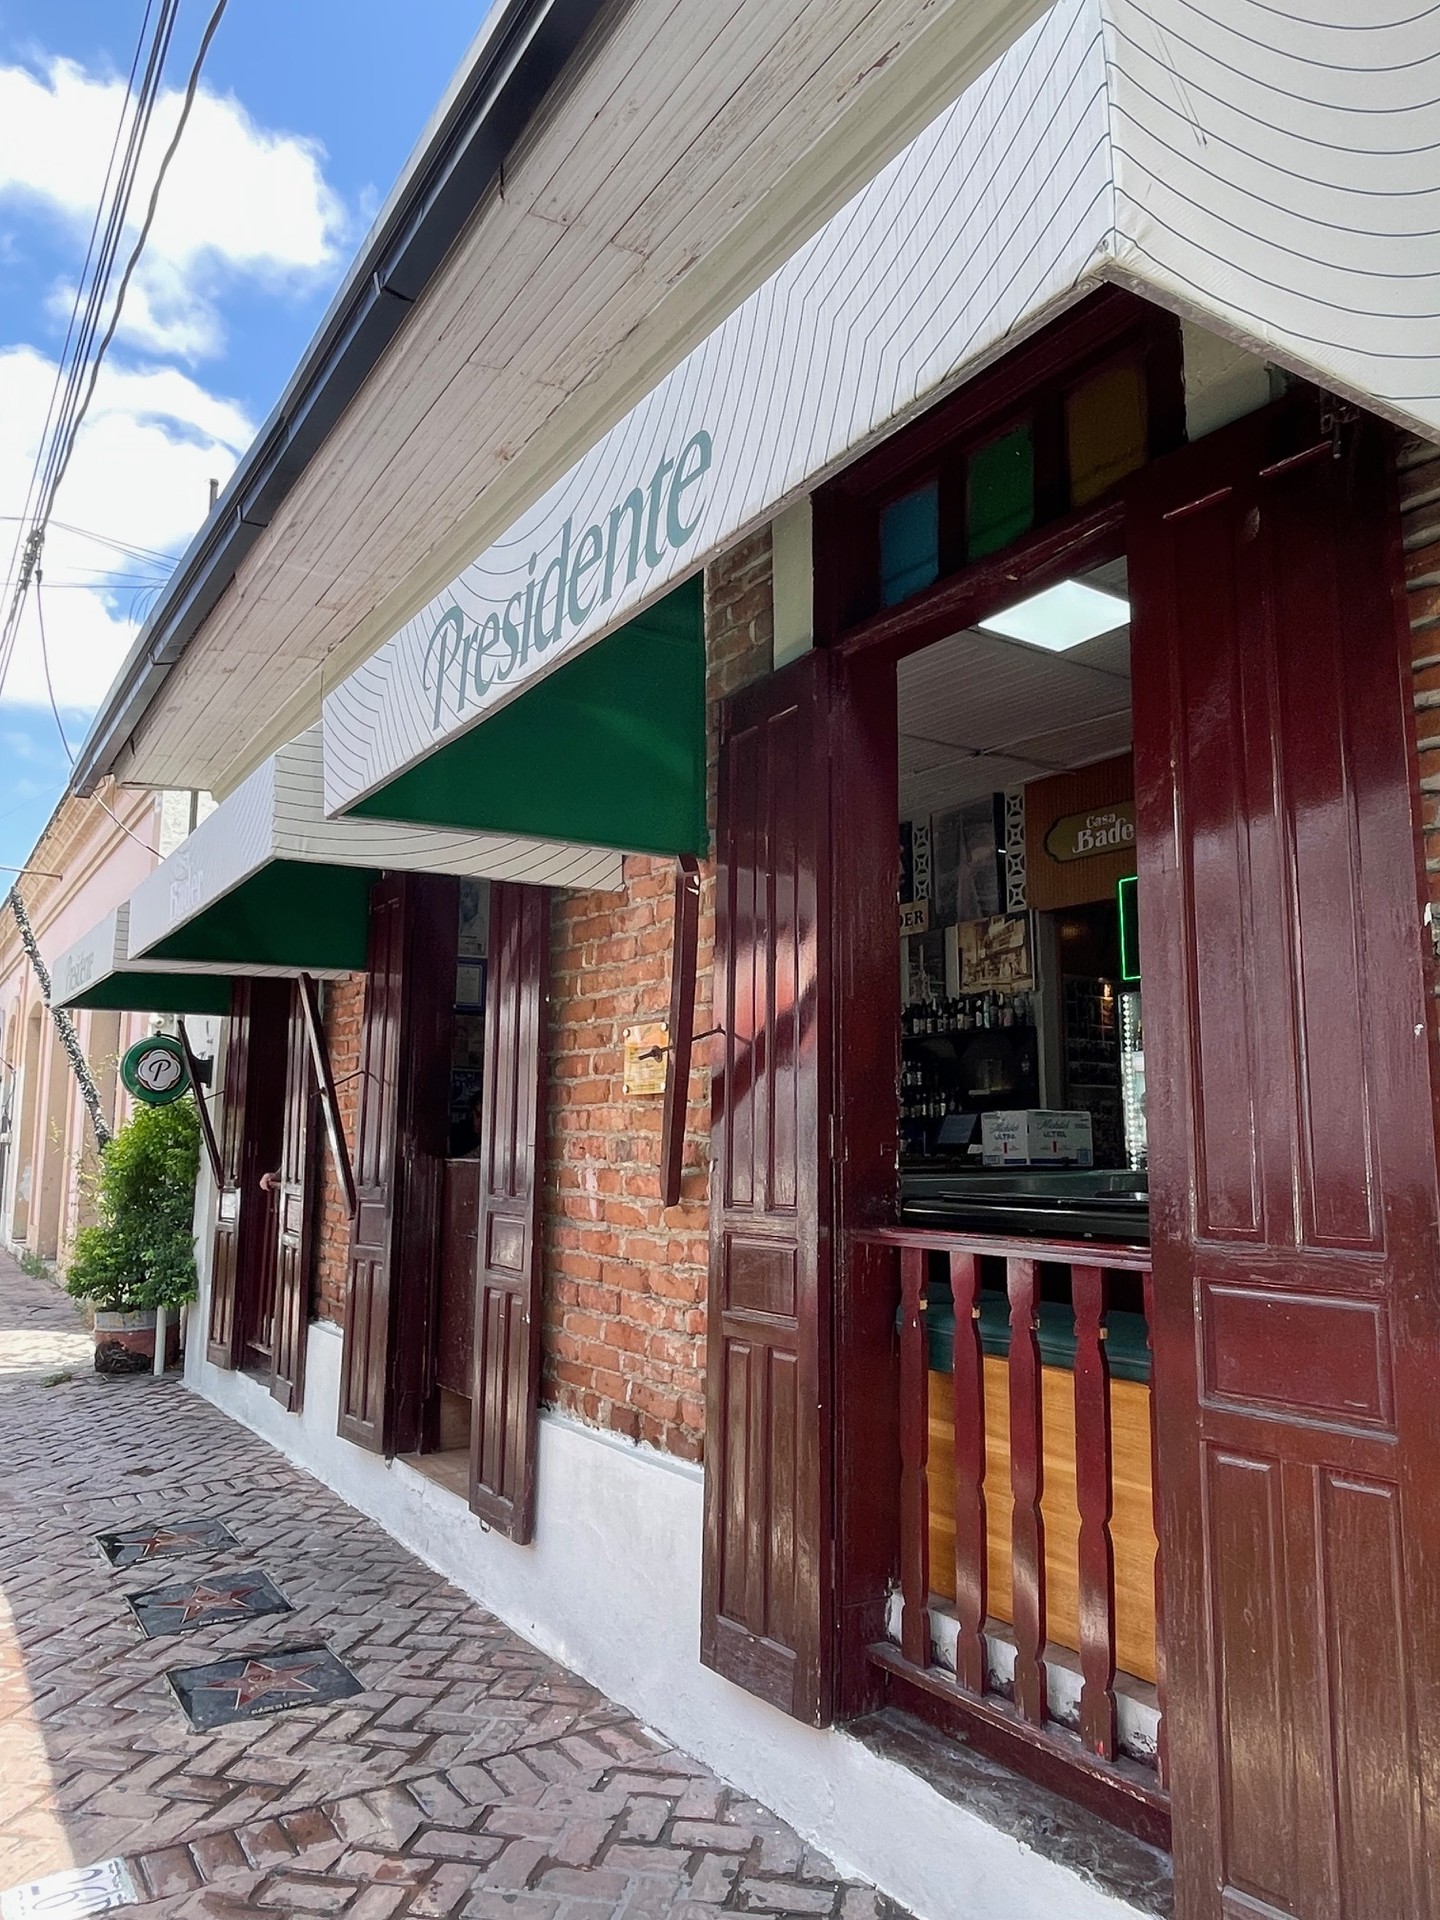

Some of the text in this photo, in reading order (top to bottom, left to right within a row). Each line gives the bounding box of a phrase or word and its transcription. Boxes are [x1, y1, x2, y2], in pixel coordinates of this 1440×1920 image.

[422, 429, 713, 731] Presidente
[1086, 813, 1116, 829] Casa
[1072, 817, 1135, 853] Bade
[148, 1059, 172, 1082] P
[994, 1132, 1017, 1140] ULTRA
[1043, 1130, 1067, 1138] ULTRA
